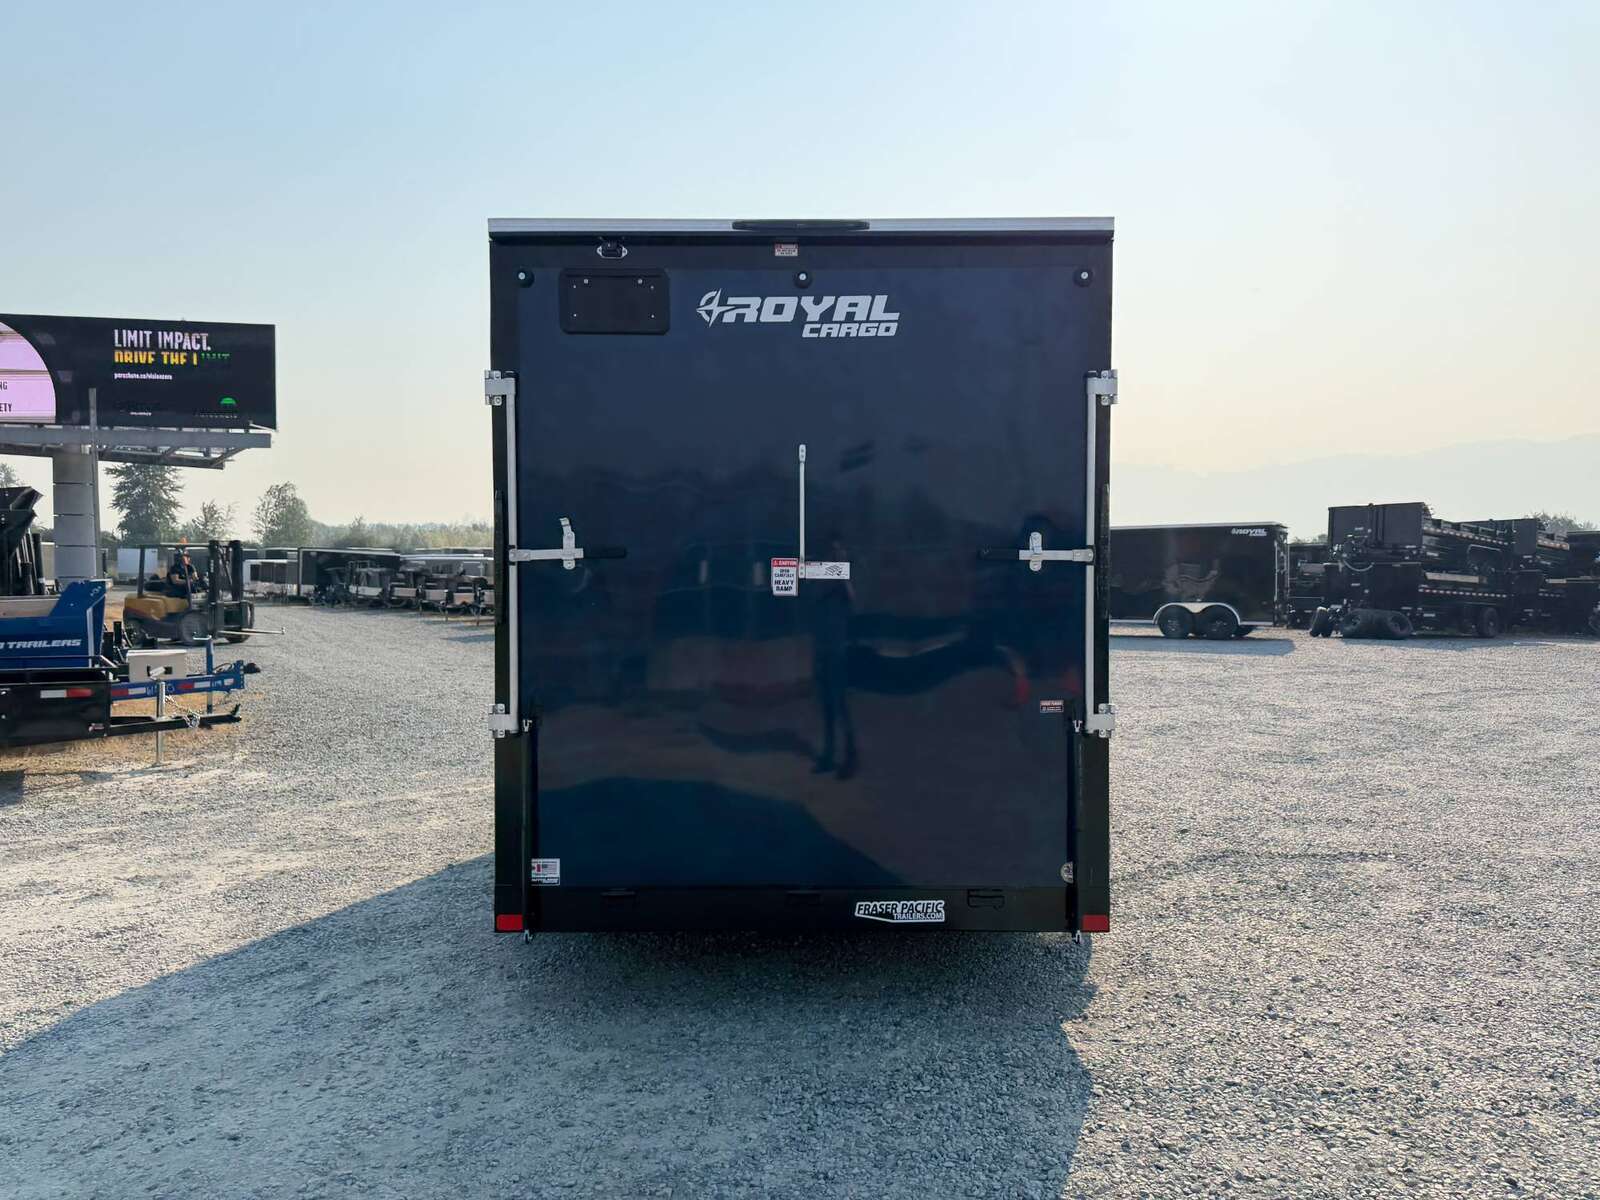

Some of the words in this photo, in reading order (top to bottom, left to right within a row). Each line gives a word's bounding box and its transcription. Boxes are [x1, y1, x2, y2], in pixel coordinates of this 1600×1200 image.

[722, 295, 900, 322] ROYAL
[802, 322, 898, 338] CARGO
[114, 329, 152, 348] LIMIT
[158, 331, 211, 351] IMPACT.
[7, 639, 82, 649] TRAILERS
[857, 902, 898, 915] FRASER
[900, 901, 943, 914] PACIFIC
[894, 912, 942, 920] TRAILERS.COM
